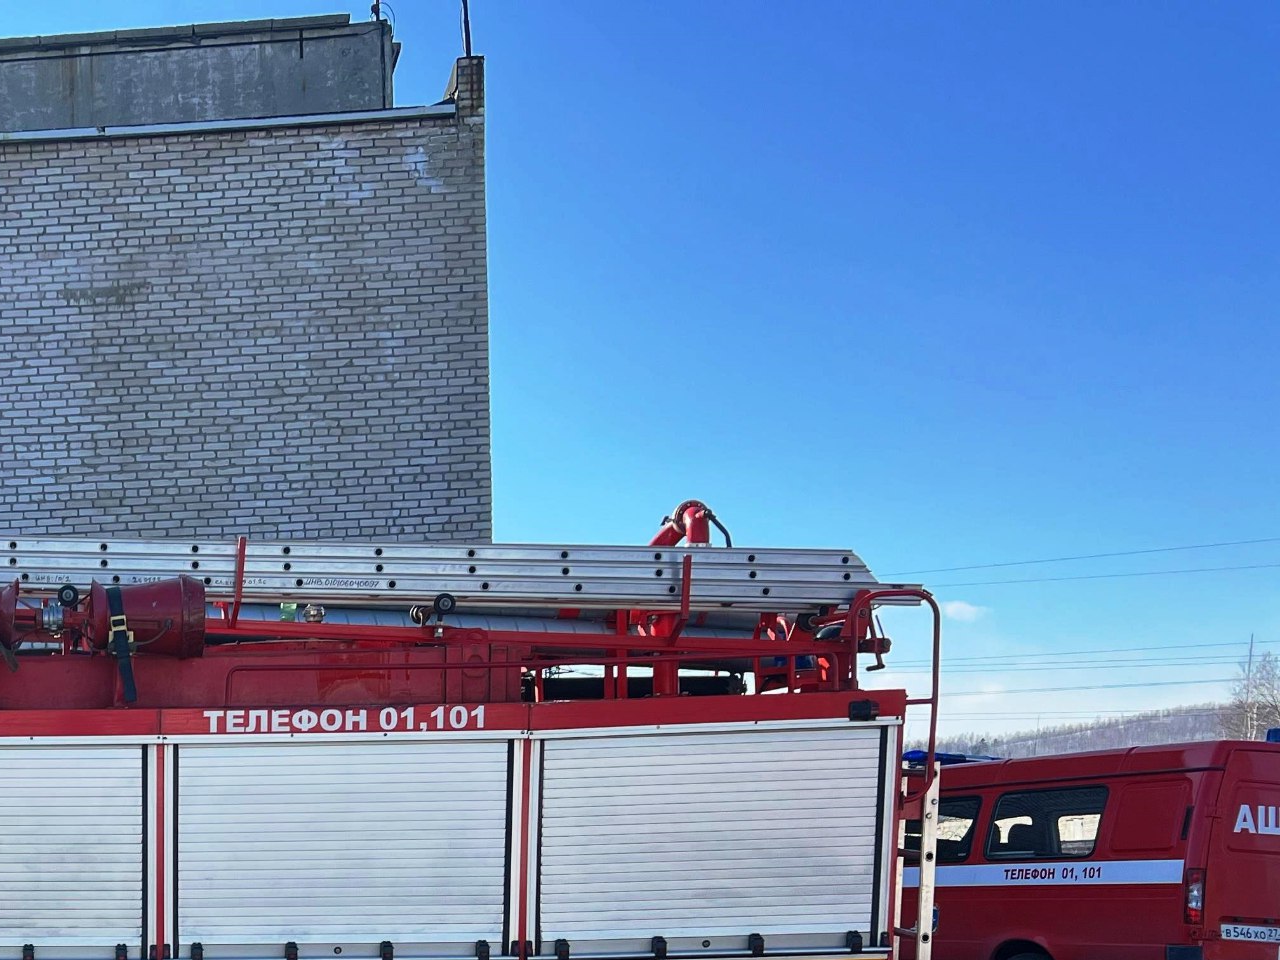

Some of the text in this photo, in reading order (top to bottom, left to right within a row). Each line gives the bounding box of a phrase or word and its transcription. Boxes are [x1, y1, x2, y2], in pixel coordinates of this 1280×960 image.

[203, 705, 485, 733] ТЕЛЕФОН 01,101
[1004, 868, 1055, 880] ТЕЛЕФОН
